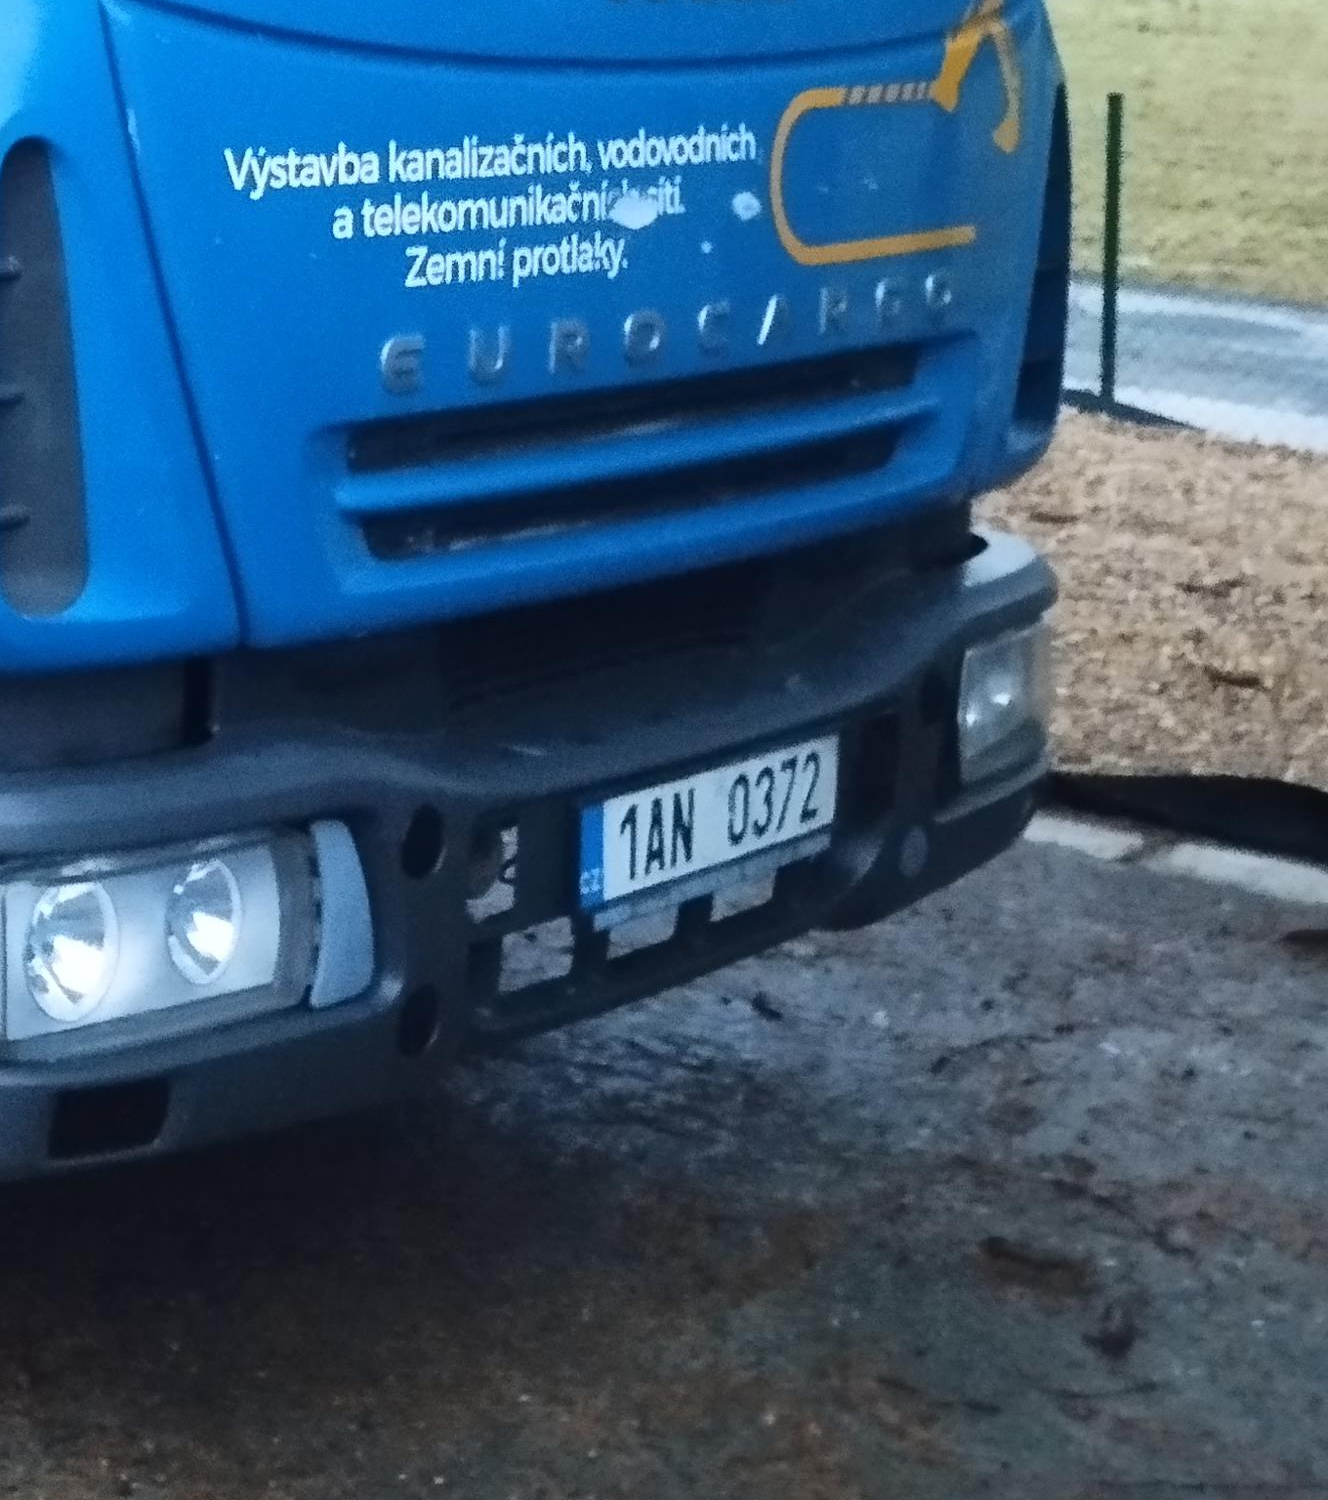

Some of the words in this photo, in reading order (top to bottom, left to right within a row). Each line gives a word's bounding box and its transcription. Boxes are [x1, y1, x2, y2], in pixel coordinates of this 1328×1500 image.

[223, 140, 380, 201] Výstavba
[389, 132, 593, 183] kanalizačních,
[597, 122, 756, 171] vodovodních
[332, 205, 354, 239] a
[405, 237, 507, 288] Zemní
[512, 231, 628, 288] protlaky.
[620, 788, 695, 880] 1AN
[728, 752, 821, 847] 0372
